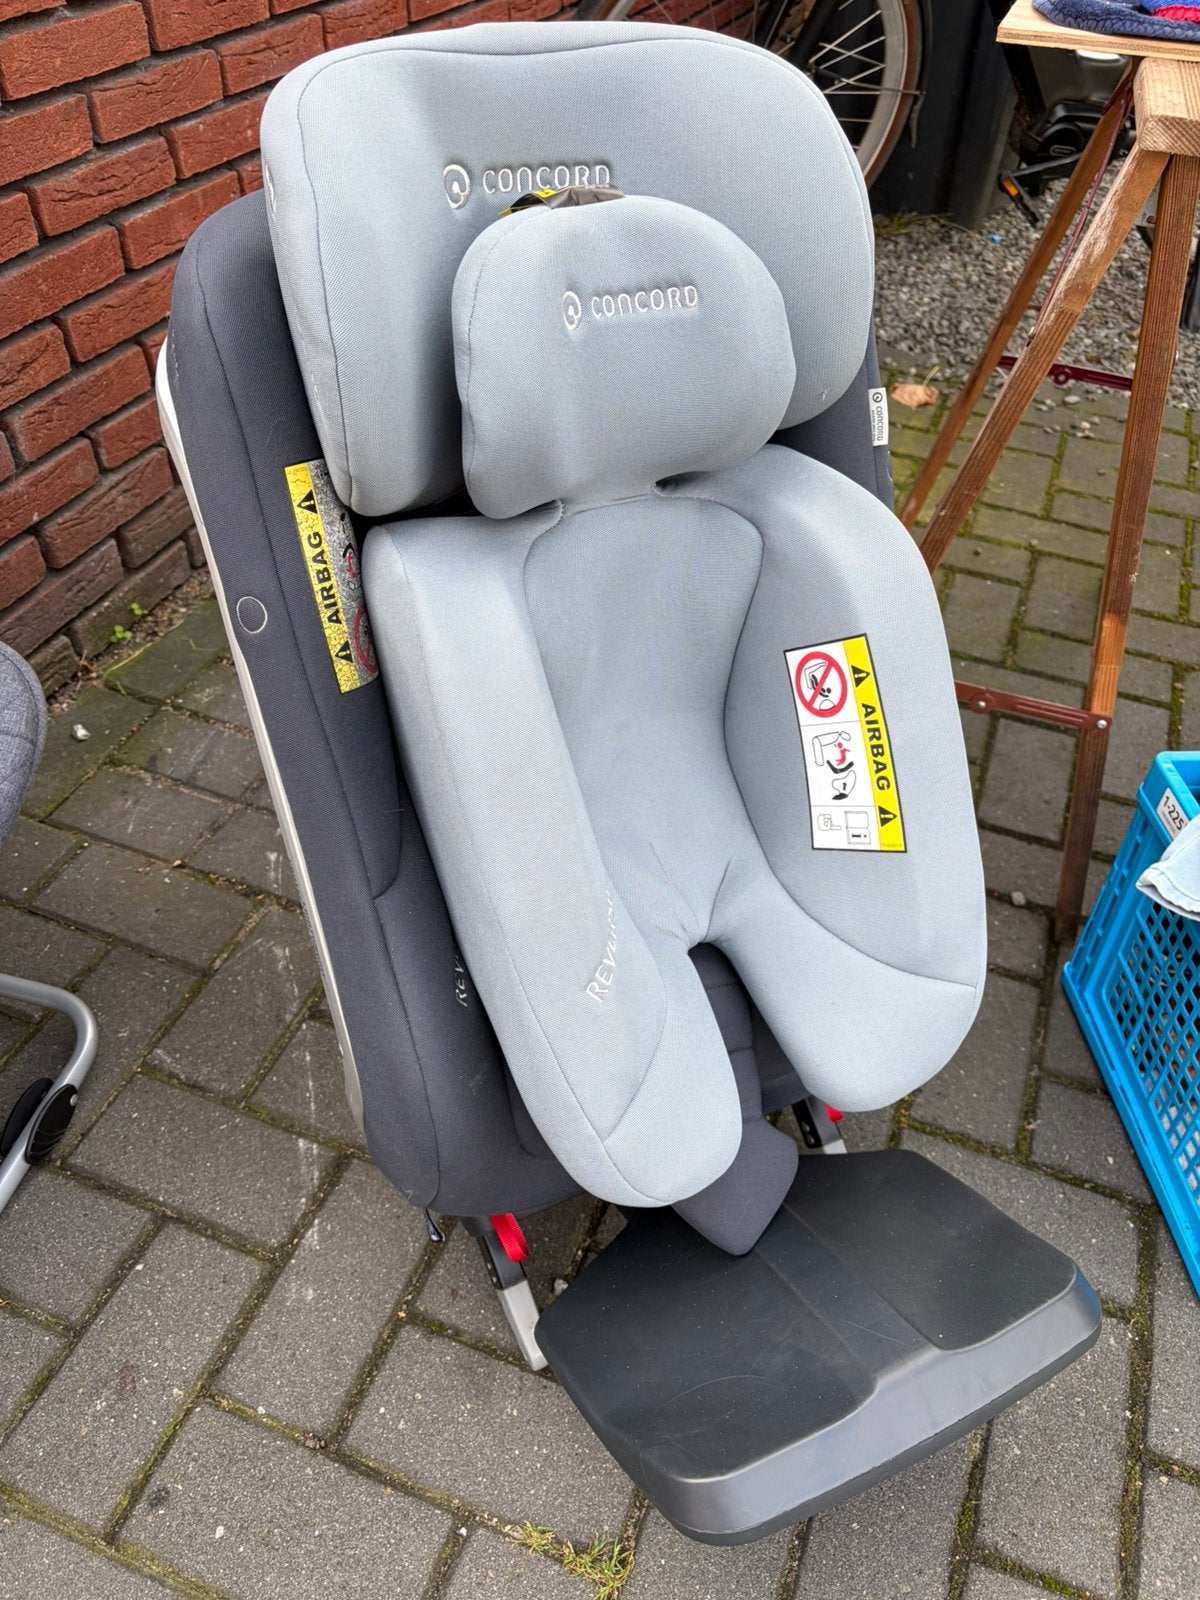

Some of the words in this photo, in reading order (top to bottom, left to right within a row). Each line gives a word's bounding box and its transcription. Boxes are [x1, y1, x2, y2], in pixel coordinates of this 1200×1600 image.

[482, 164, 611, 194] CONCORD
[591, 285, 699, 319] CONCORD
[875, 405, 884, 442] CONCORD
[307, 531, 342, 625] AIRBAG
[861, 703, 891, 791] AIRBAG
[1163, 795, 1188, 831] 1-225
